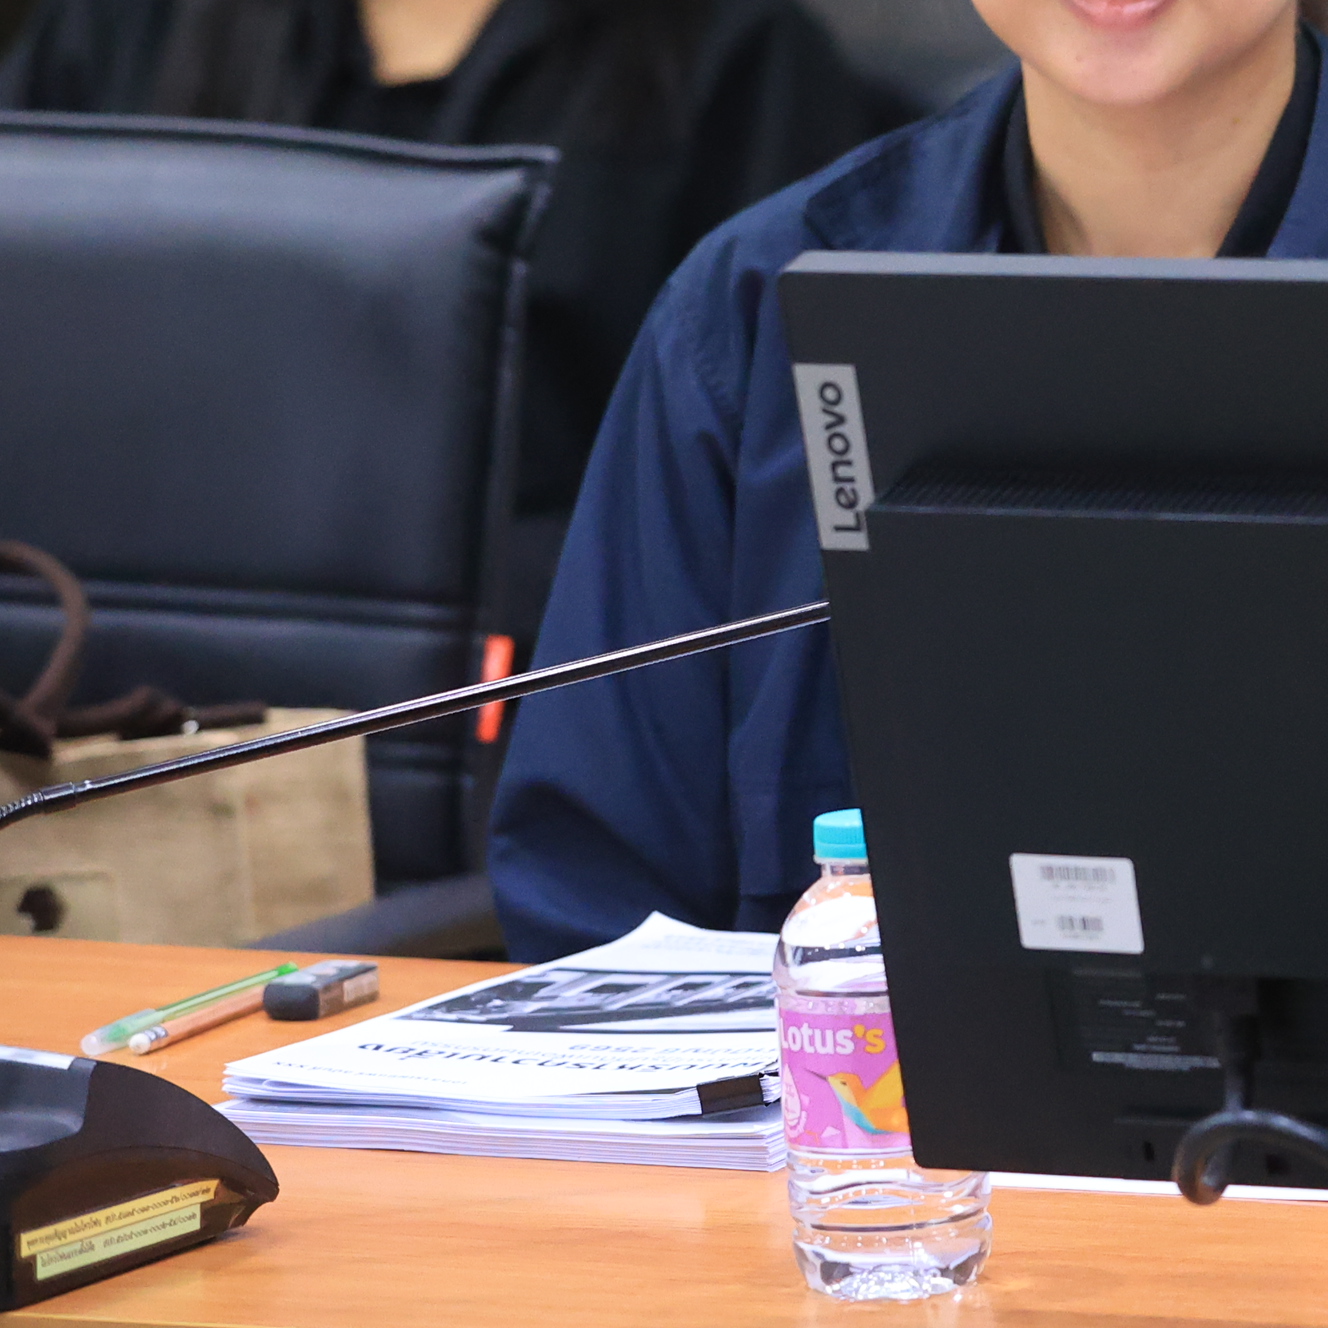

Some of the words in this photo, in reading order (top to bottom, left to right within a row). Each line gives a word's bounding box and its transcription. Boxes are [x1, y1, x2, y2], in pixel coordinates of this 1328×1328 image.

[819, 380, 863, 533] Lenovo
[780, 1016, 887, 1055] Lotus's
[357, 1042, 765, 1072] ผนบริหารความเสี่ยง
